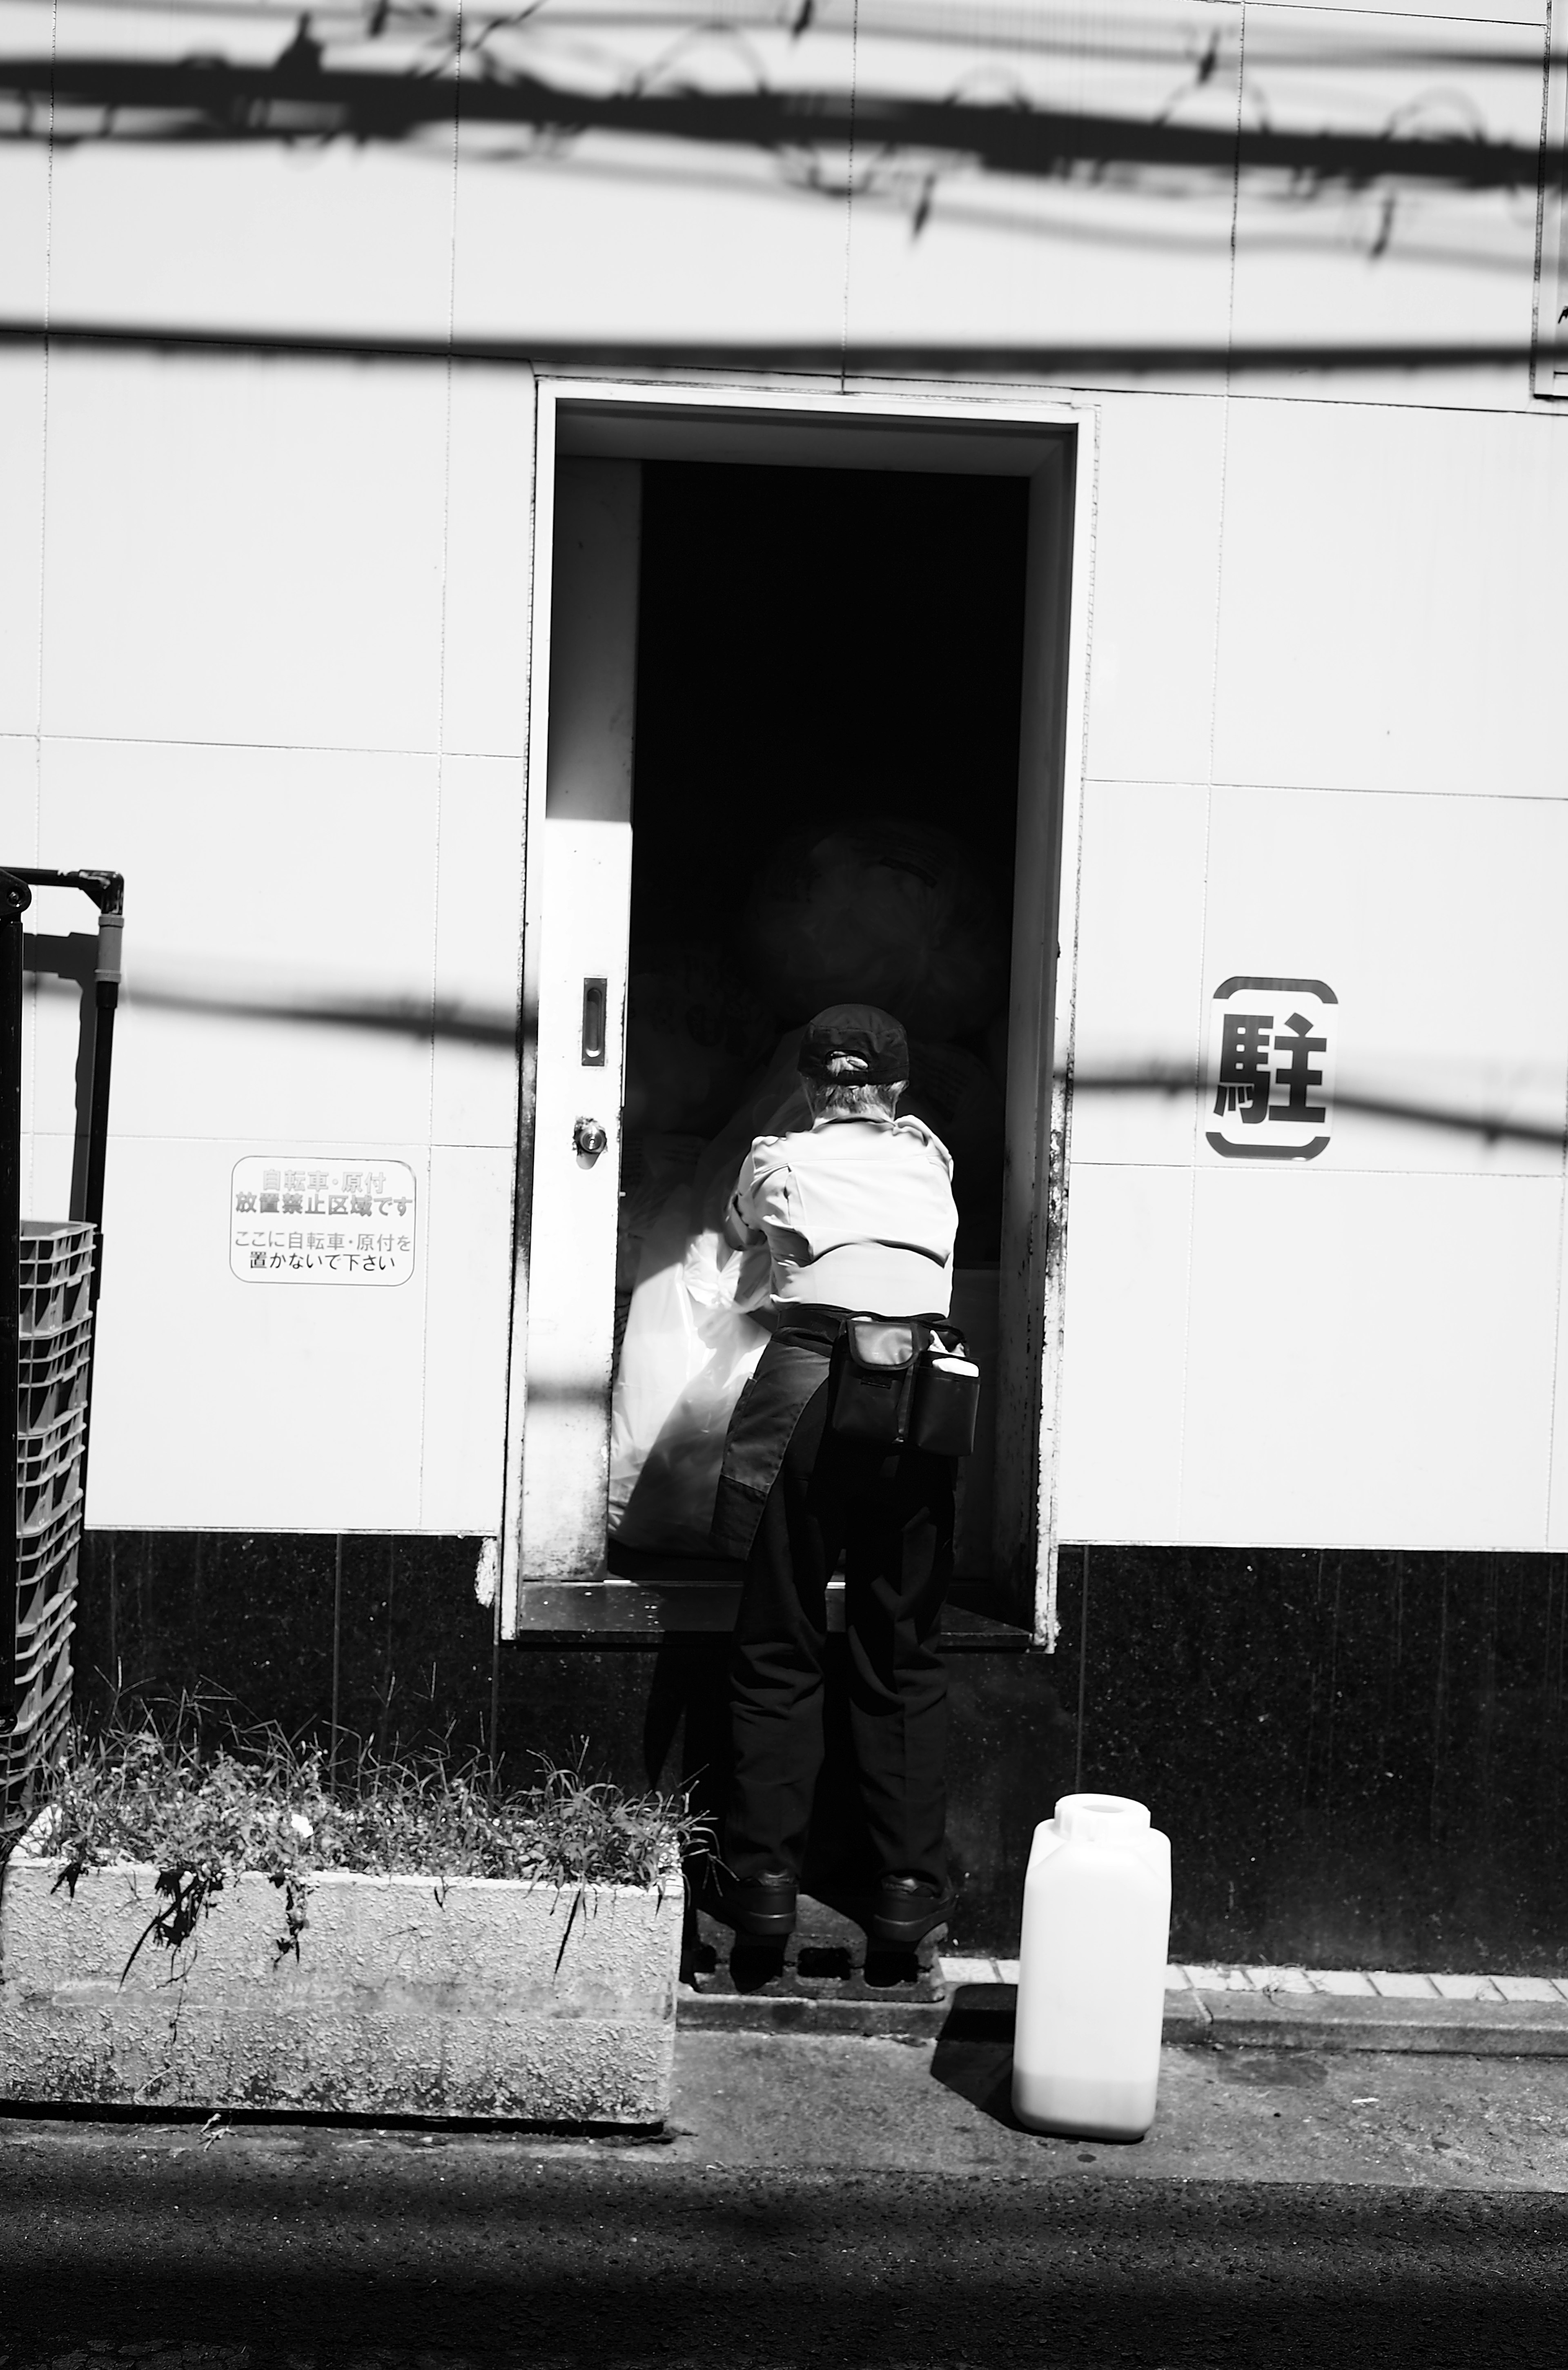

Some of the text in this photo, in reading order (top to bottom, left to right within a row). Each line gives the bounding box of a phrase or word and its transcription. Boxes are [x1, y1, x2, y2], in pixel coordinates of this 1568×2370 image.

[1214, 1013, 1327, 1124] 駐
[263, 1169, 386, 1194] 自転車・原付
[235, 1192, 413, 1216] 放置禁止区域です
[235, 1231, 411, 1252] ここに自転車・原付を
[250, 1251, 395, 1272] 置かないで下さい
